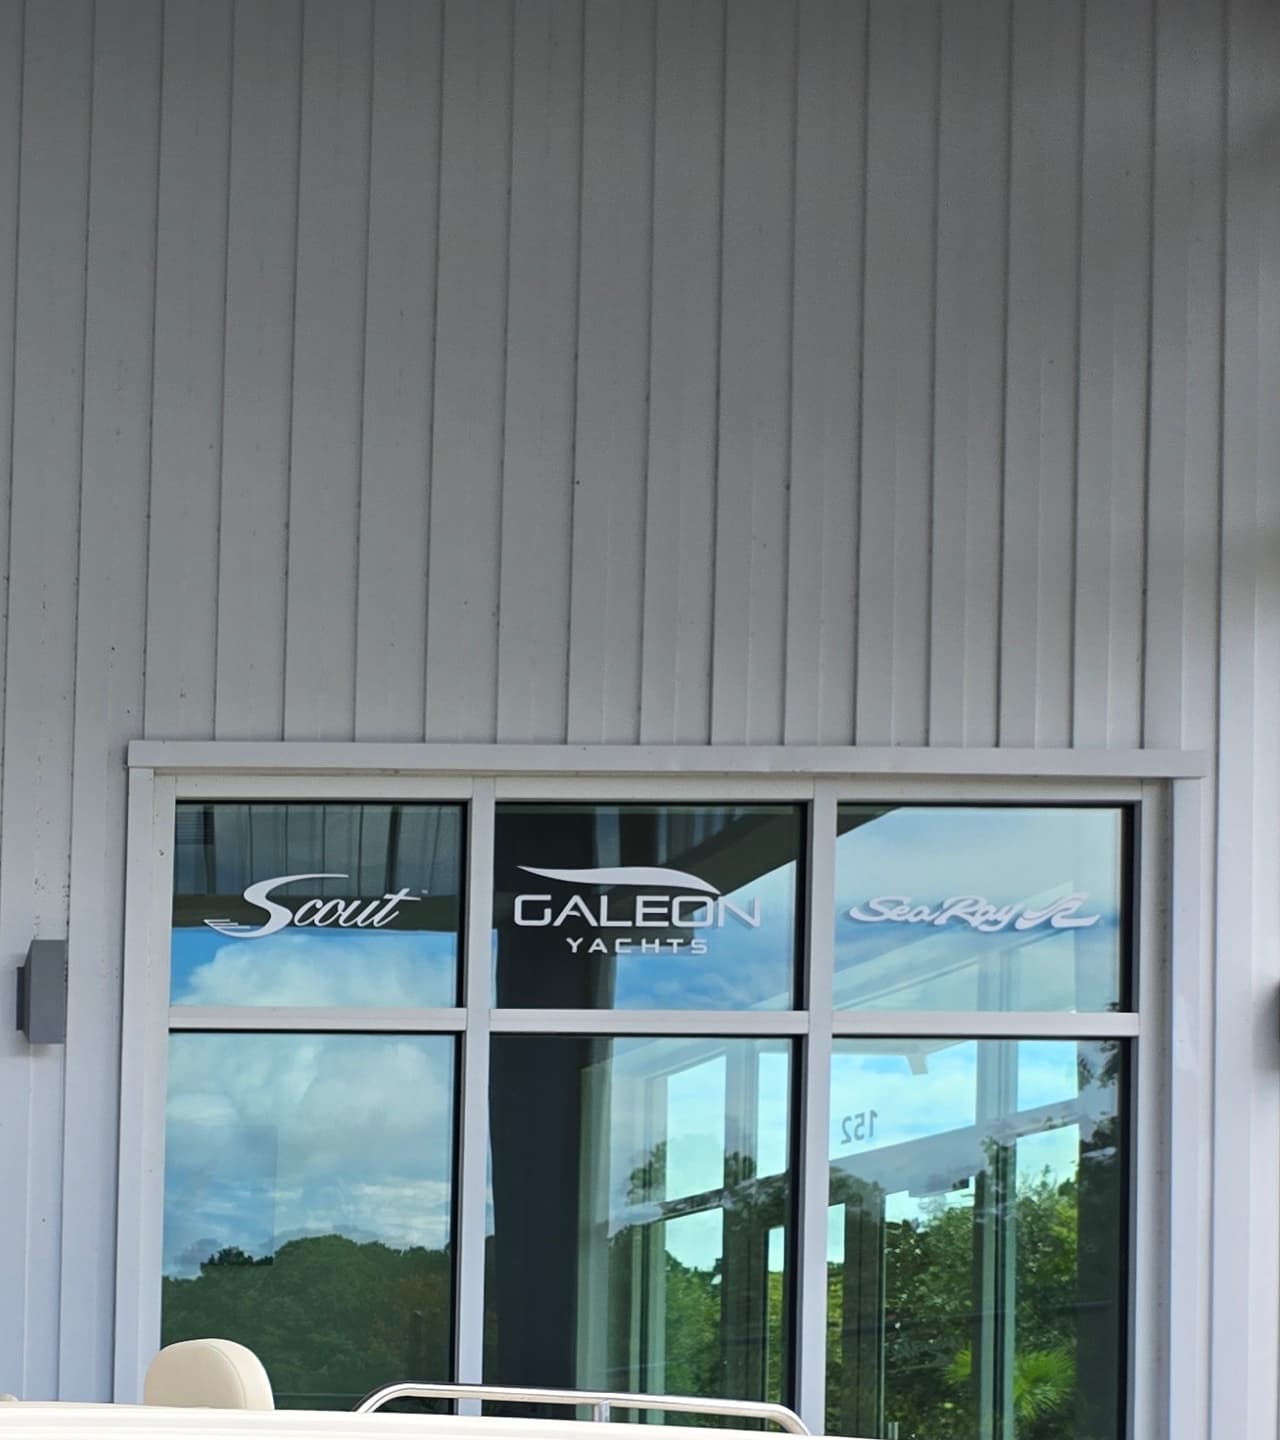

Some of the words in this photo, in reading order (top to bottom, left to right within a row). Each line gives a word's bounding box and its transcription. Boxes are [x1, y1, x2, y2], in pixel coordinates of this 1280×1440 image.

[203, 873, 421, 938] Scout
[514, 894, 762, 928] GALEON
[849, 896, 940, 922] Sea
[566, 937, 708, 954] YACHTS
